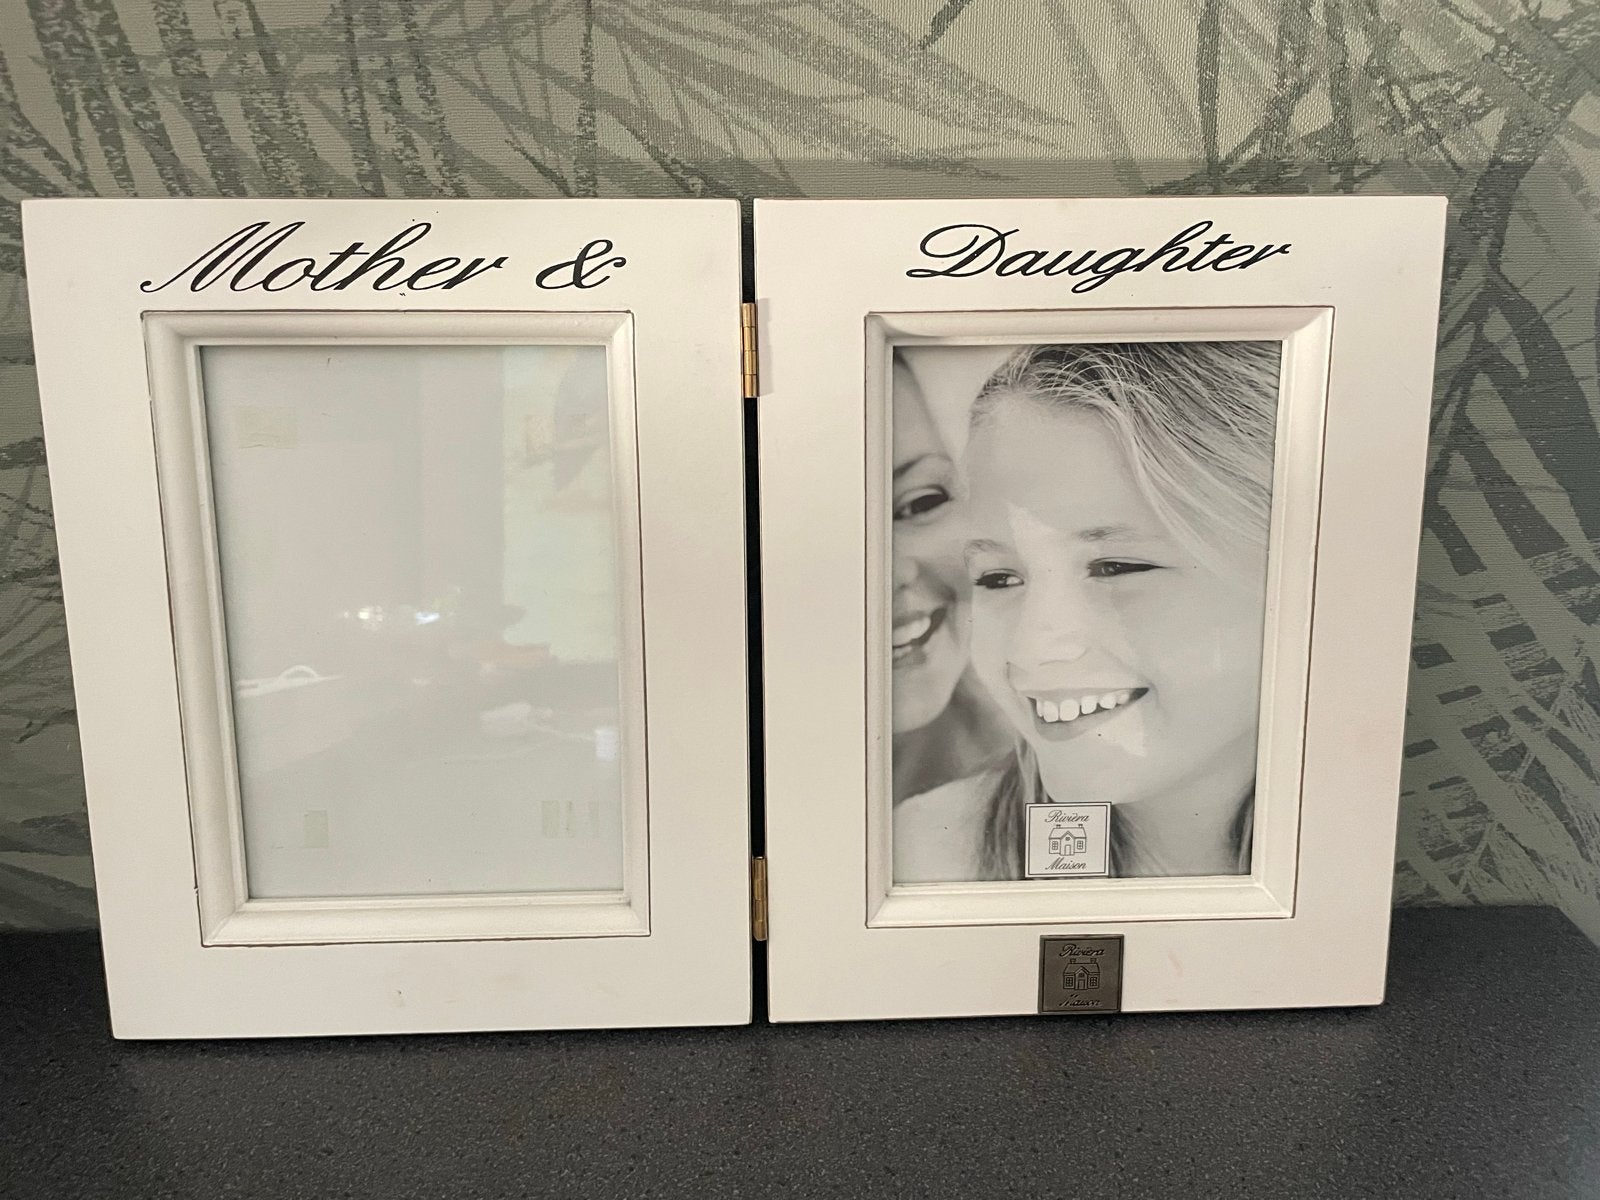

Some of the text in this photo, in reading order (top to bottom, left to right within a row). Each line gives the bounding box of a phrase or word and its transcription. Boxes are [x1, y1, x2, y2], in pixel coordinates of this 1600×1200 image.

[140, 221, 626, 292] Mother &
[906, 220, 1292, 294] Daughter
[1044, 857, 1087, 870] Maison
